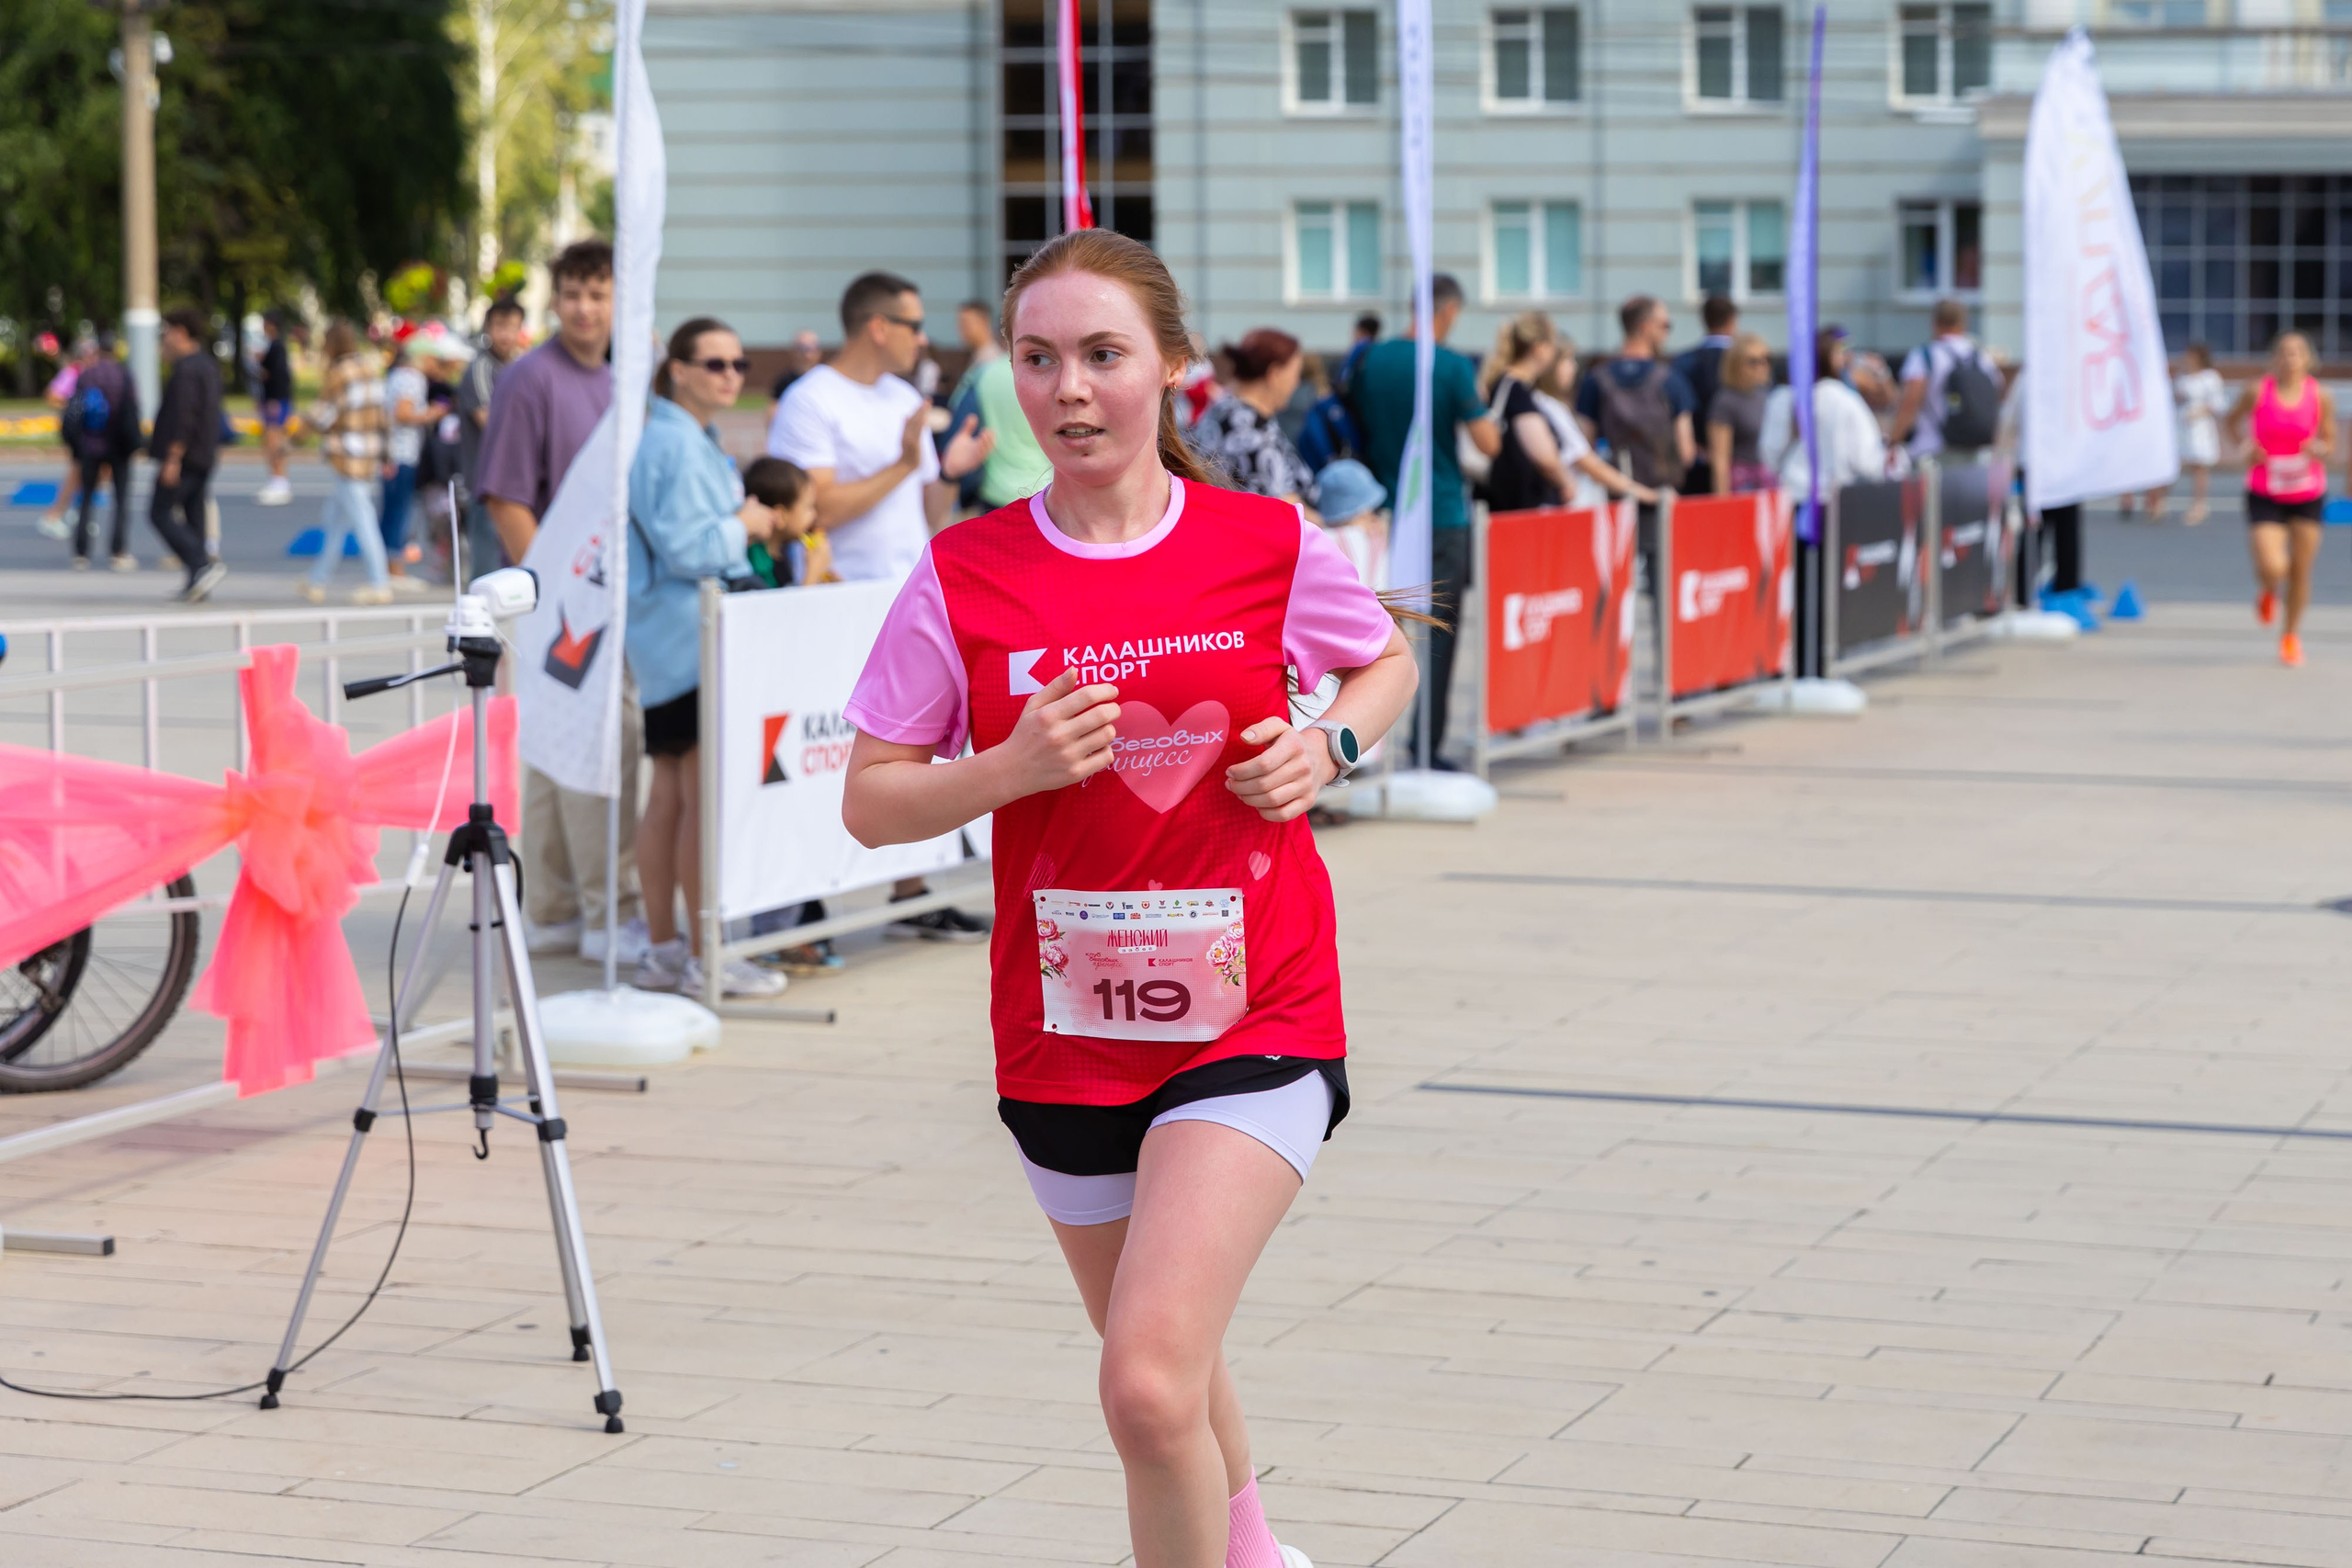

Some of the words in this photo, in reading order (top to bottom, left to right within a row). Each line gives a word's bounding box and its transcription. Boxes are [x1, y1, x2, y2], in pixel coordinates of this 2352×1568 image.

[1063, 630, 1245, 666] КАЛАШНИКОВ
[1076, 660, 1150, 685] ПОРТ
[1107, 928, 1168, 947] ЖЕНСКИЙ
[1093, 978, 1192, 1022] 119
